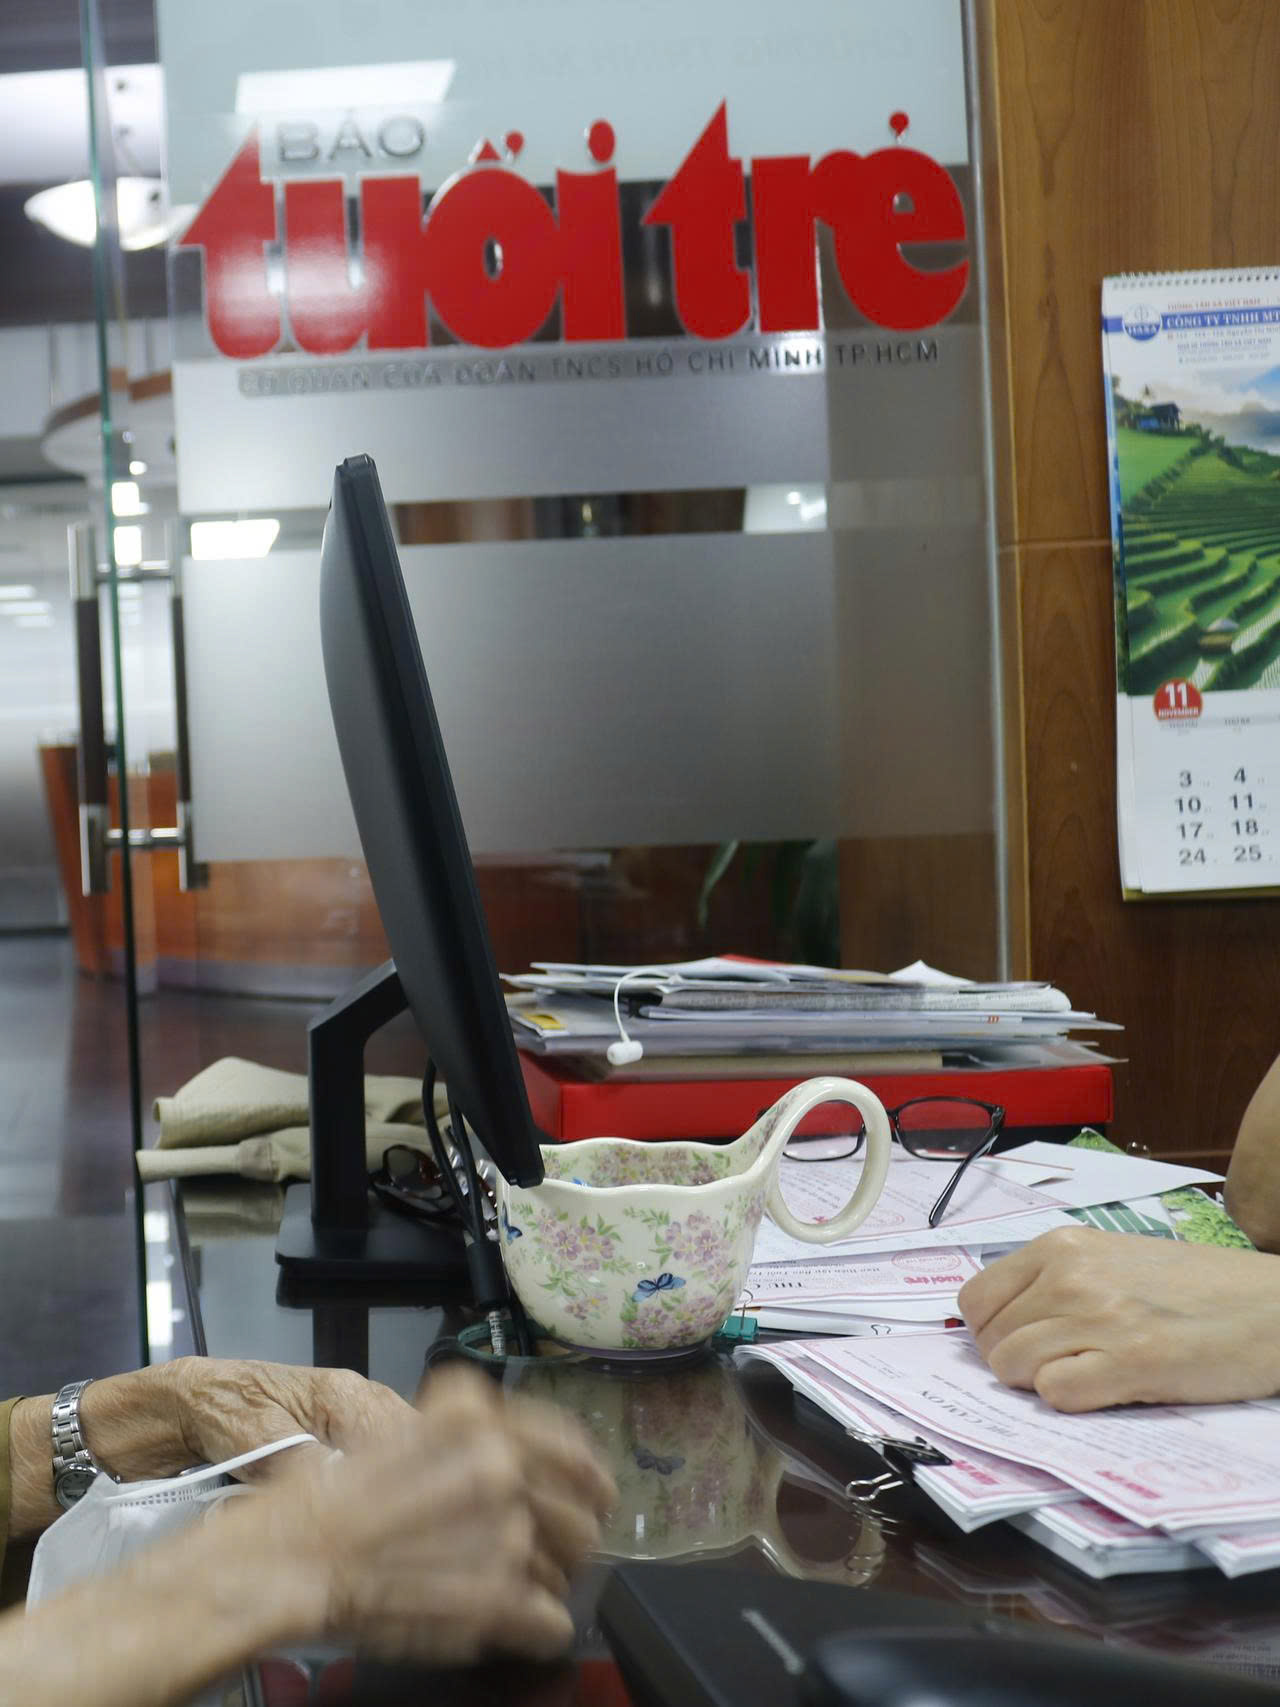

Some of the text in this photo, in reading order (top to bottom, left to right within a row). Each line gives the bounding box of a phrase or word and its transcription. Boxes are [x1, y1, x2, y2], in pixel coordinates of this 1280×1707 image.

[748, 347, 823, 370] MINH
[1165, 682, 1188, 707] 11
[1179, 767, 1246, 788] 3 4
[1175, 793, 1253, 813] 10 11
[1177, 819, 1258, 839] 17 18
[1179, 845, 1261, 866] 24 25
